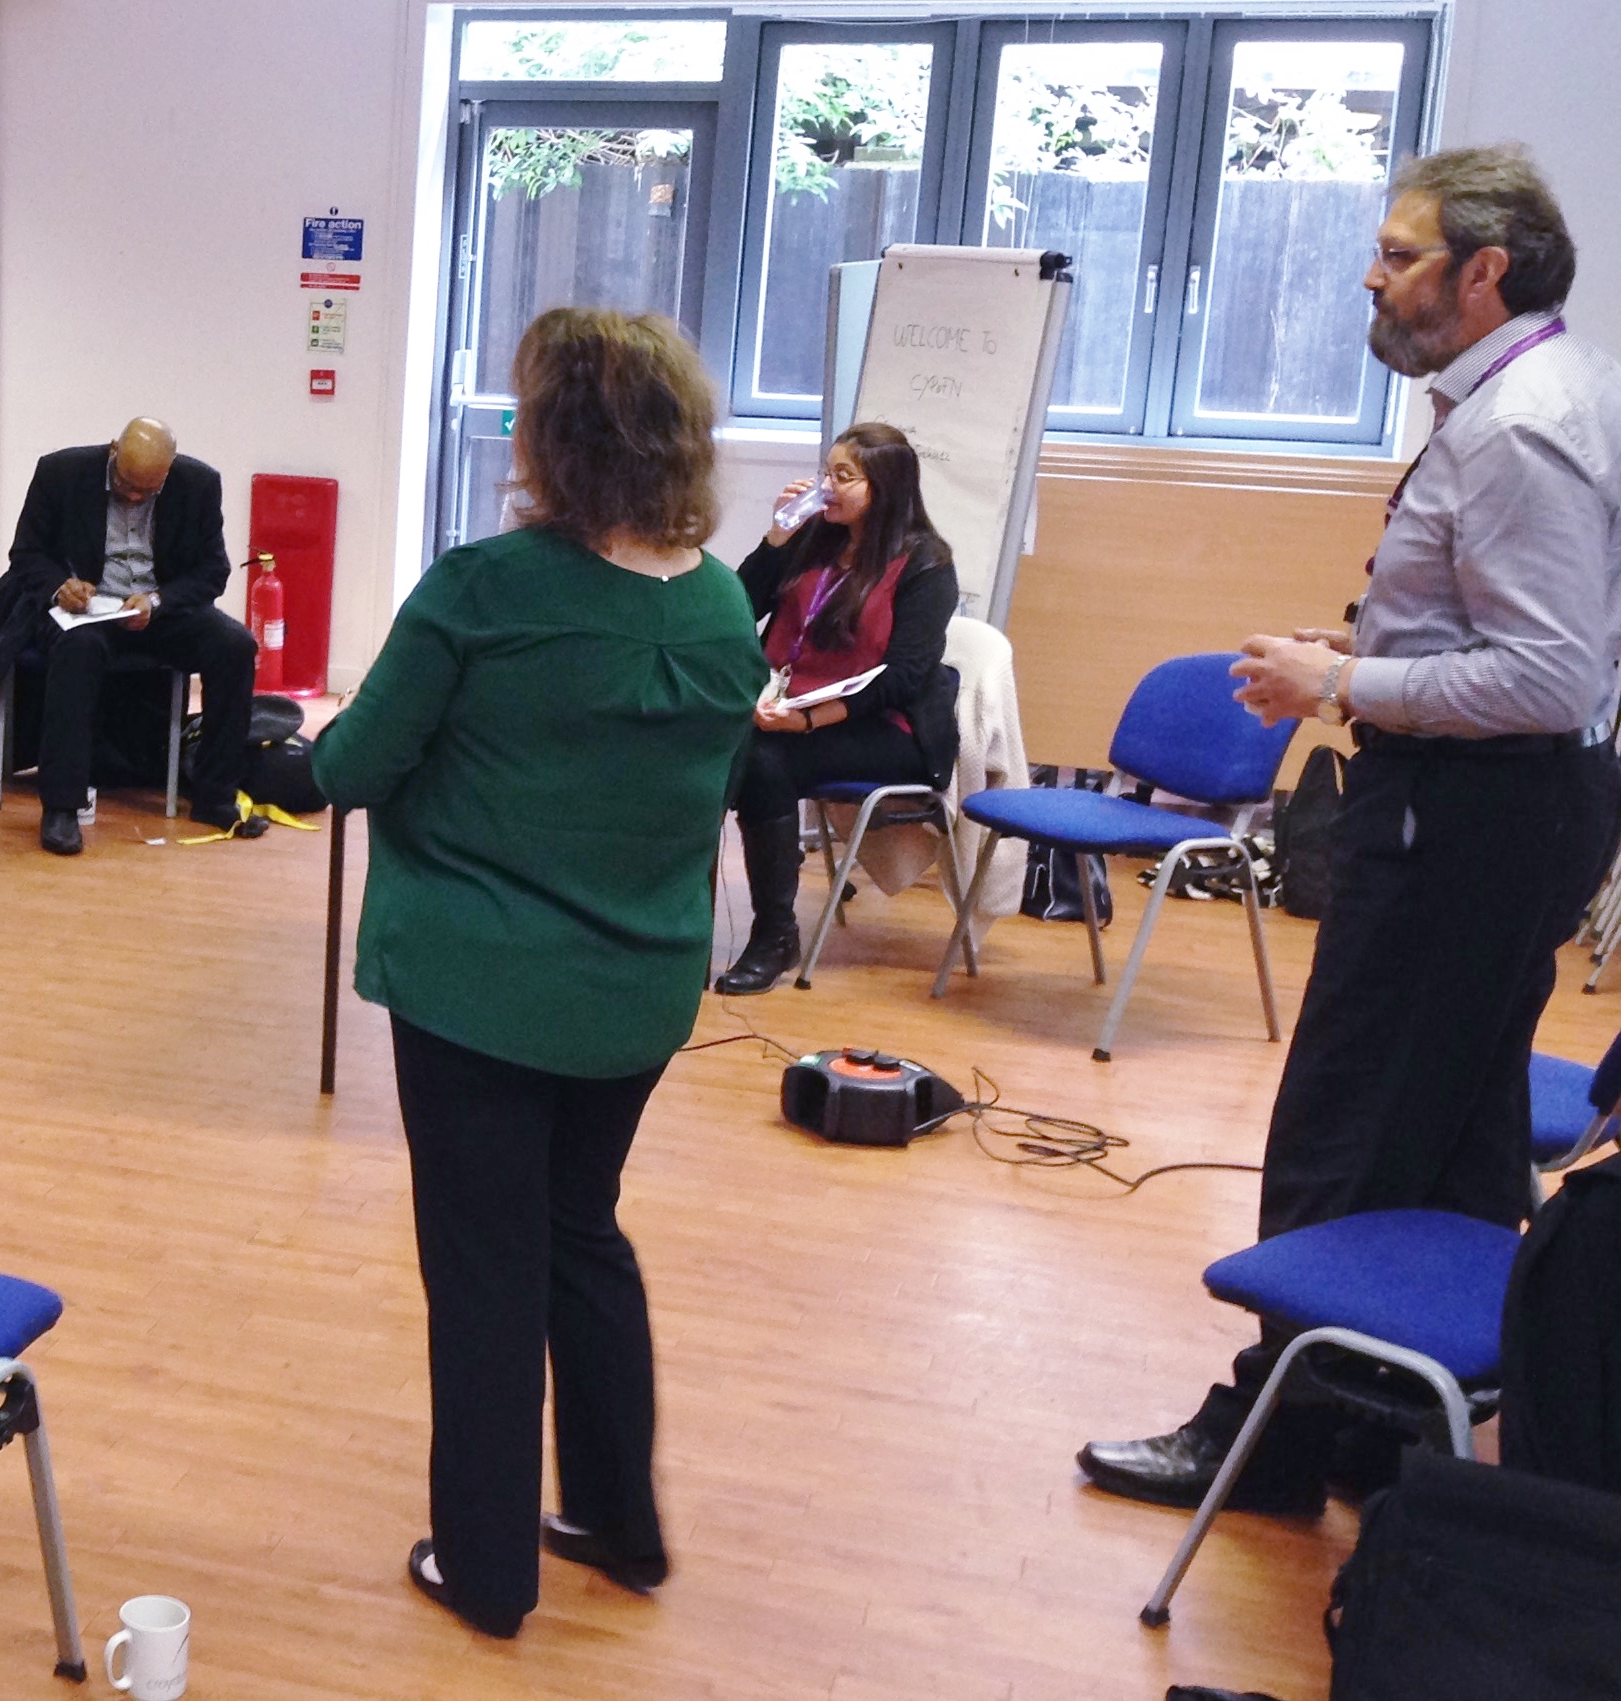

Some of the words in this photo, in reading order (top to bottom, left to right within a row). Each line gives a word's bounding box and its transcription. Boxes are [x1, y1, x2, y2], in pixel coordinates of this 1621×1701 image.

[305, 218, 326, 229] Fire
[328, 219, 362, 230] action
[892, 323, 970, 353] WELCOME
